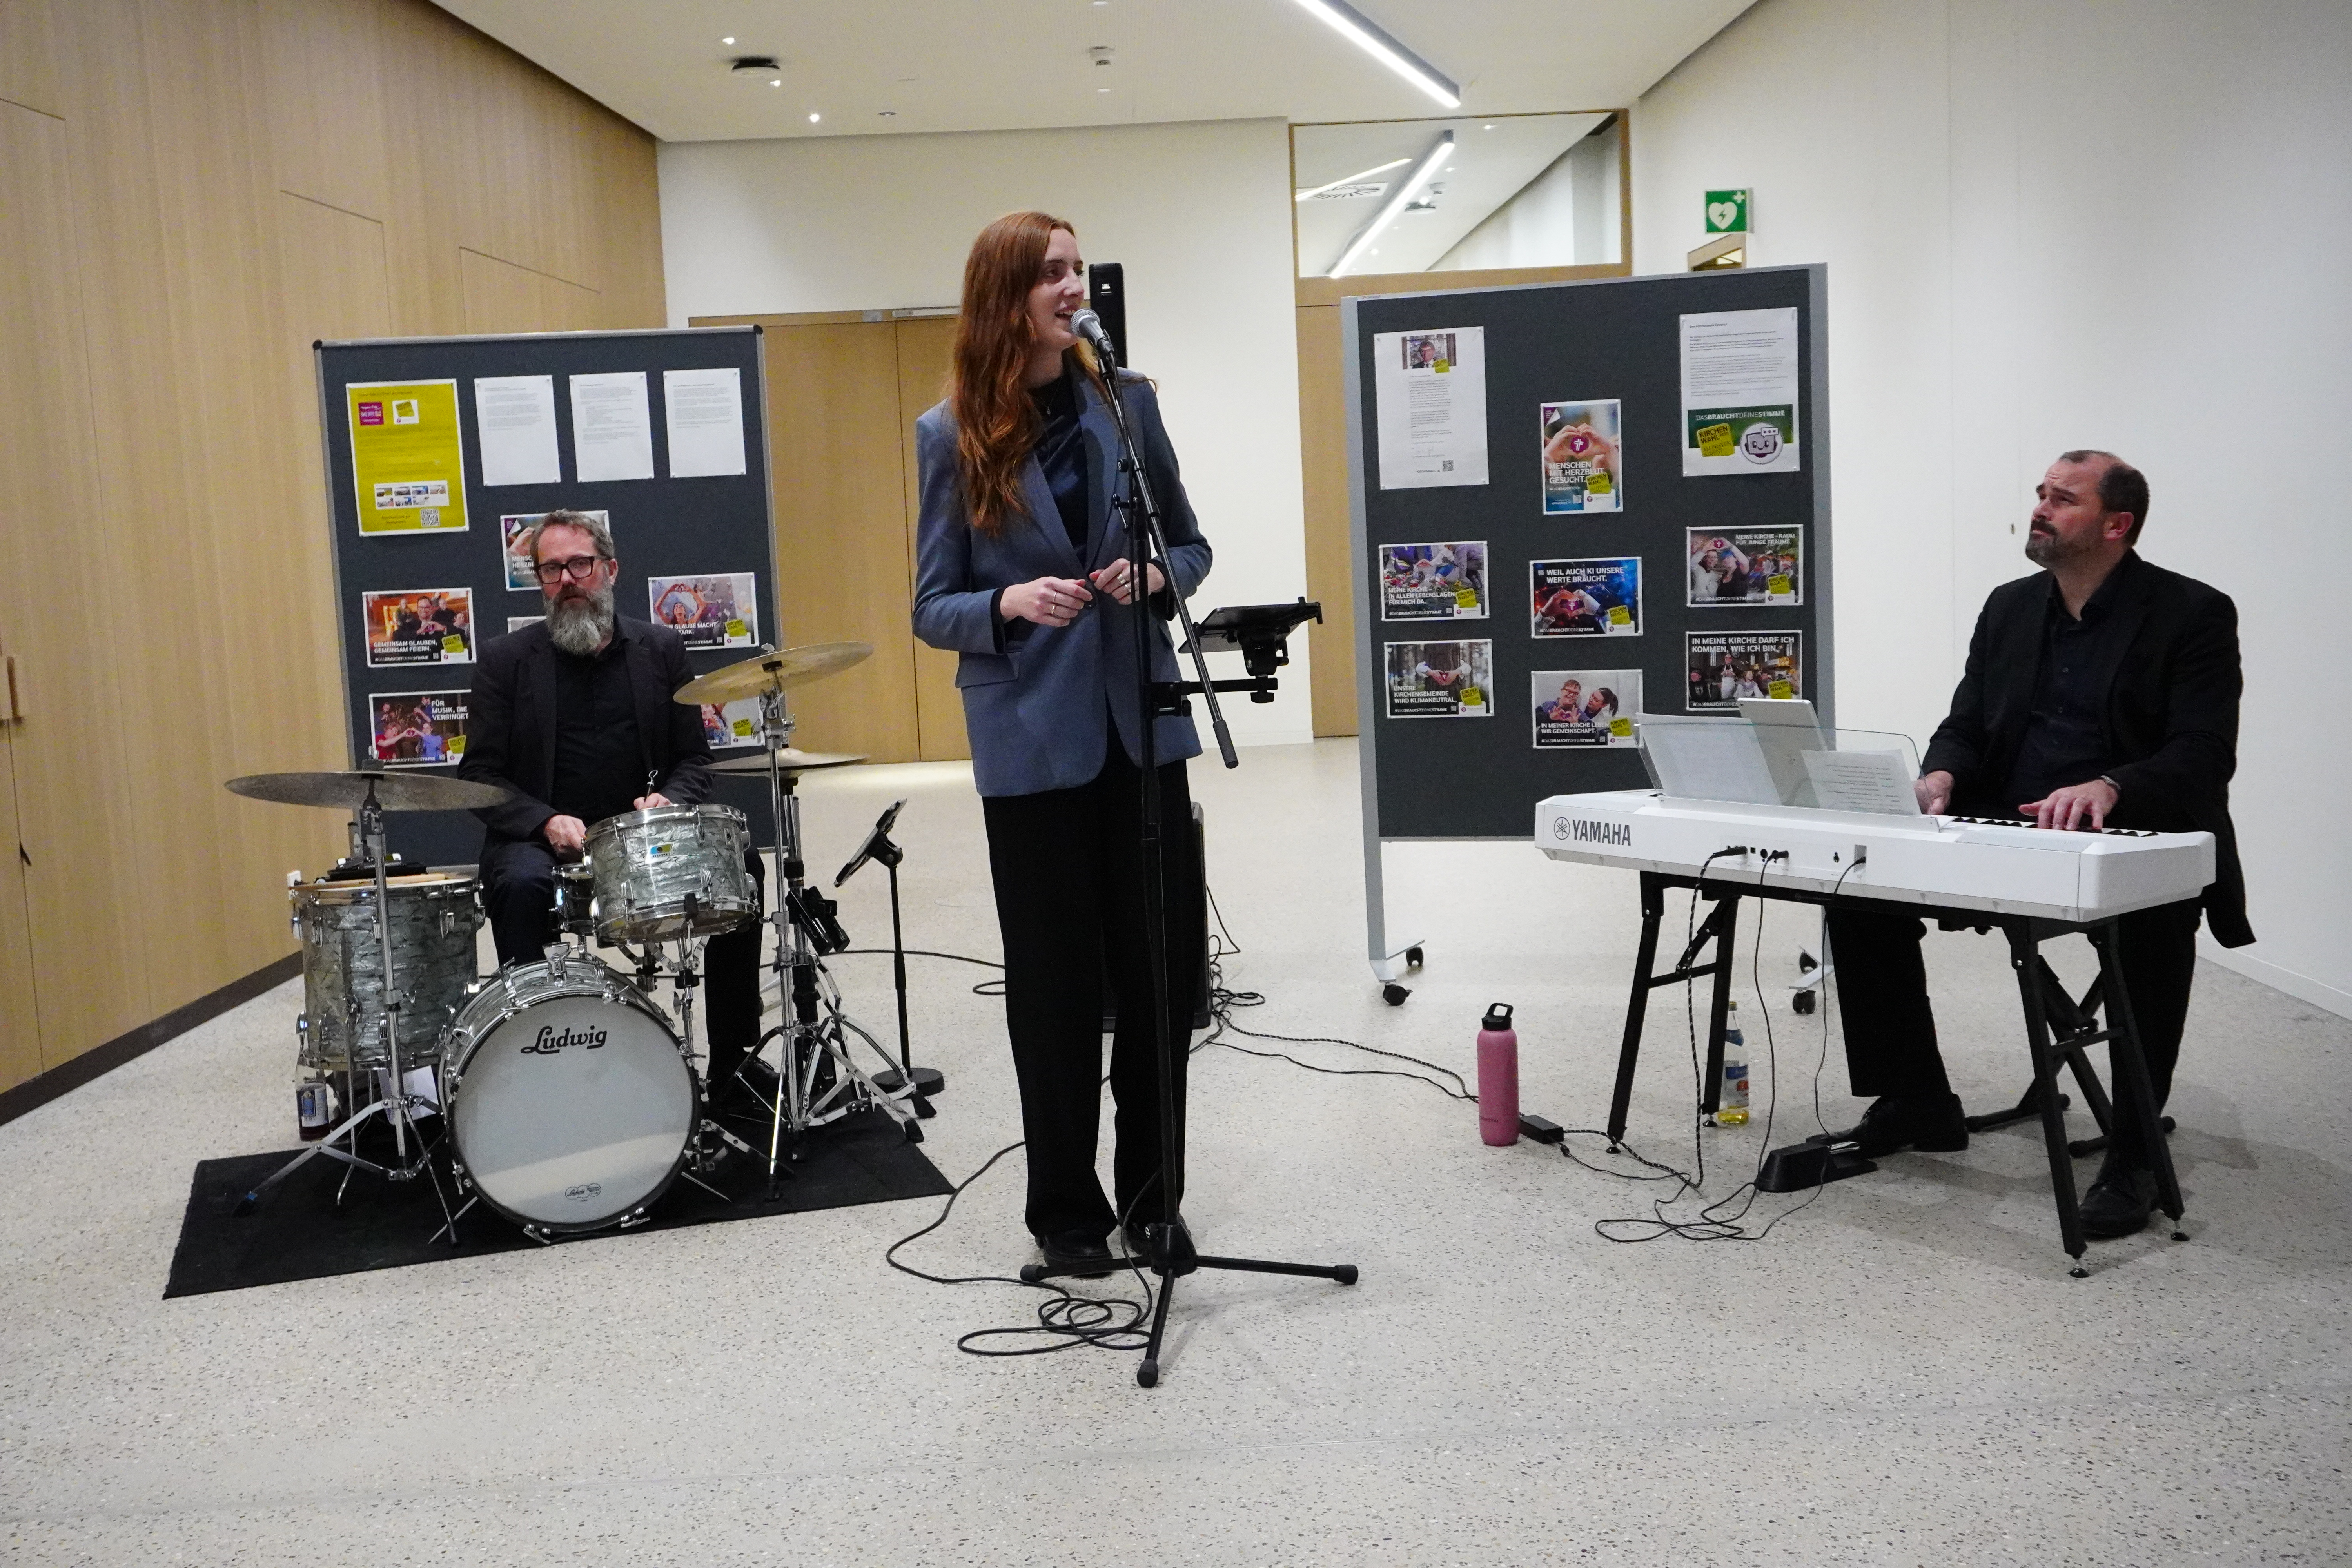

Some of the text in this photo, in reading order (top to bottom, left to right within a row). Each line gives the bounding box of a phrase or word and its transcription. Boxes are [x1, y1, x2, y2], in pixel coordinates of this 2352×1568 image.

[1696, 410, 1785, 420] DASBRAUCHTDEINESTIMME
[1699, 426, 1728, 438] KIRCHEN
[1700, 435, 1720, 443] WAHL
[1572, 819, 1631, 846] YAMAHA
[520, 1024, 607, 1054] Ludwig
